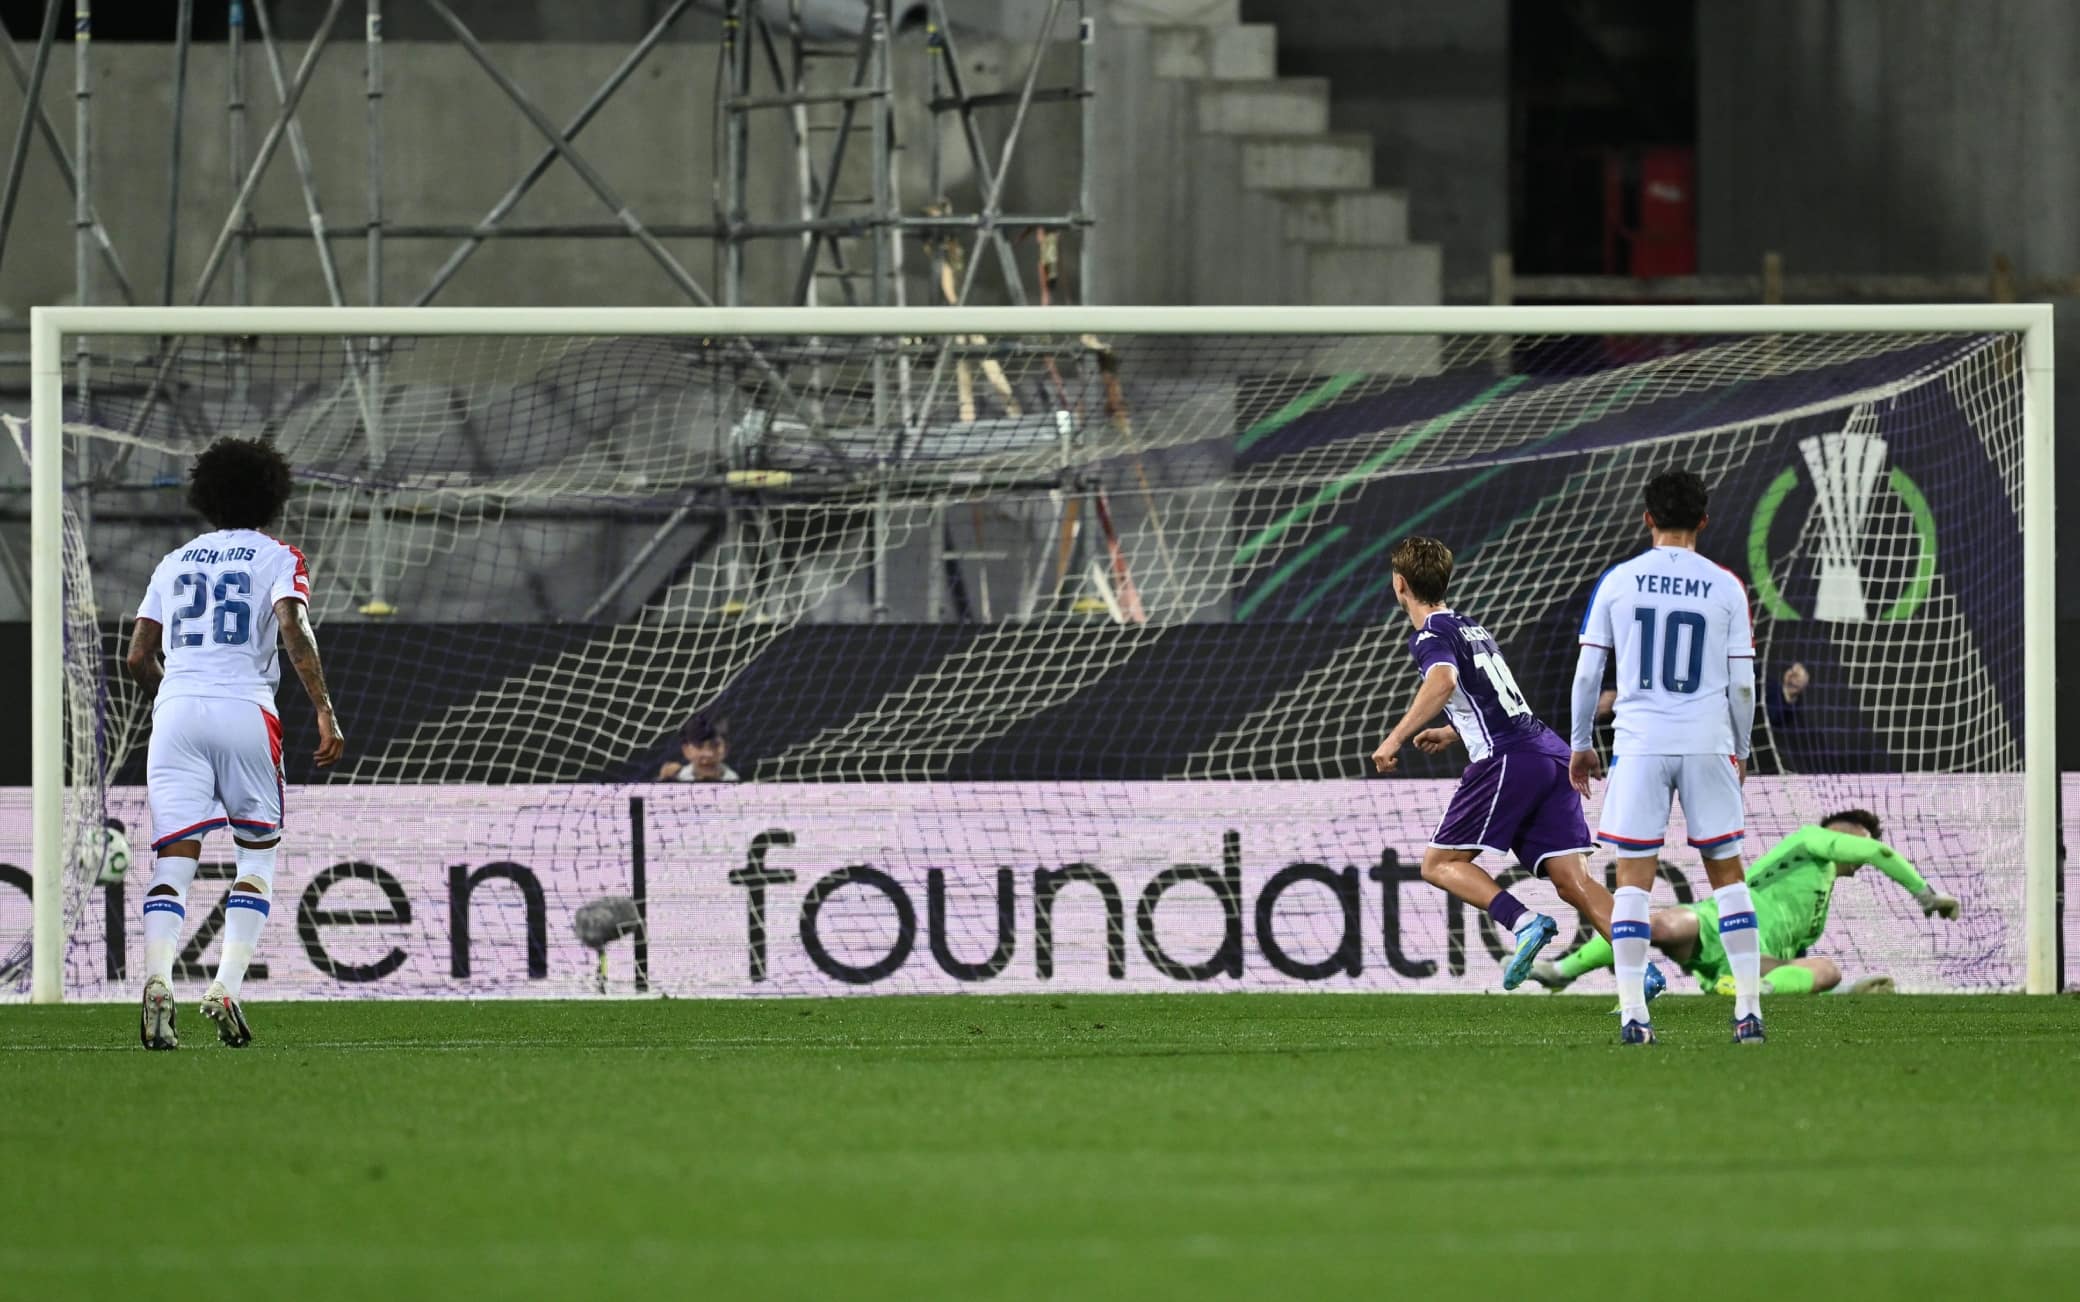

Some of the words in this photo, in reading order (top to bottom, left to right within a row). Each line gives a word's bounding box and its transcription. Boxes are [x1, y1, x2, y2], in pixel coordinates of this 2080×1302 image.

[181, 547, 257, 565] RICHARDS
[1635, 574, 1712, 599] YEREMY
[171, 571, 252, 649] 26
[1634, 606, 1707, 694] 10
[0, 819, 547, 982] izen
